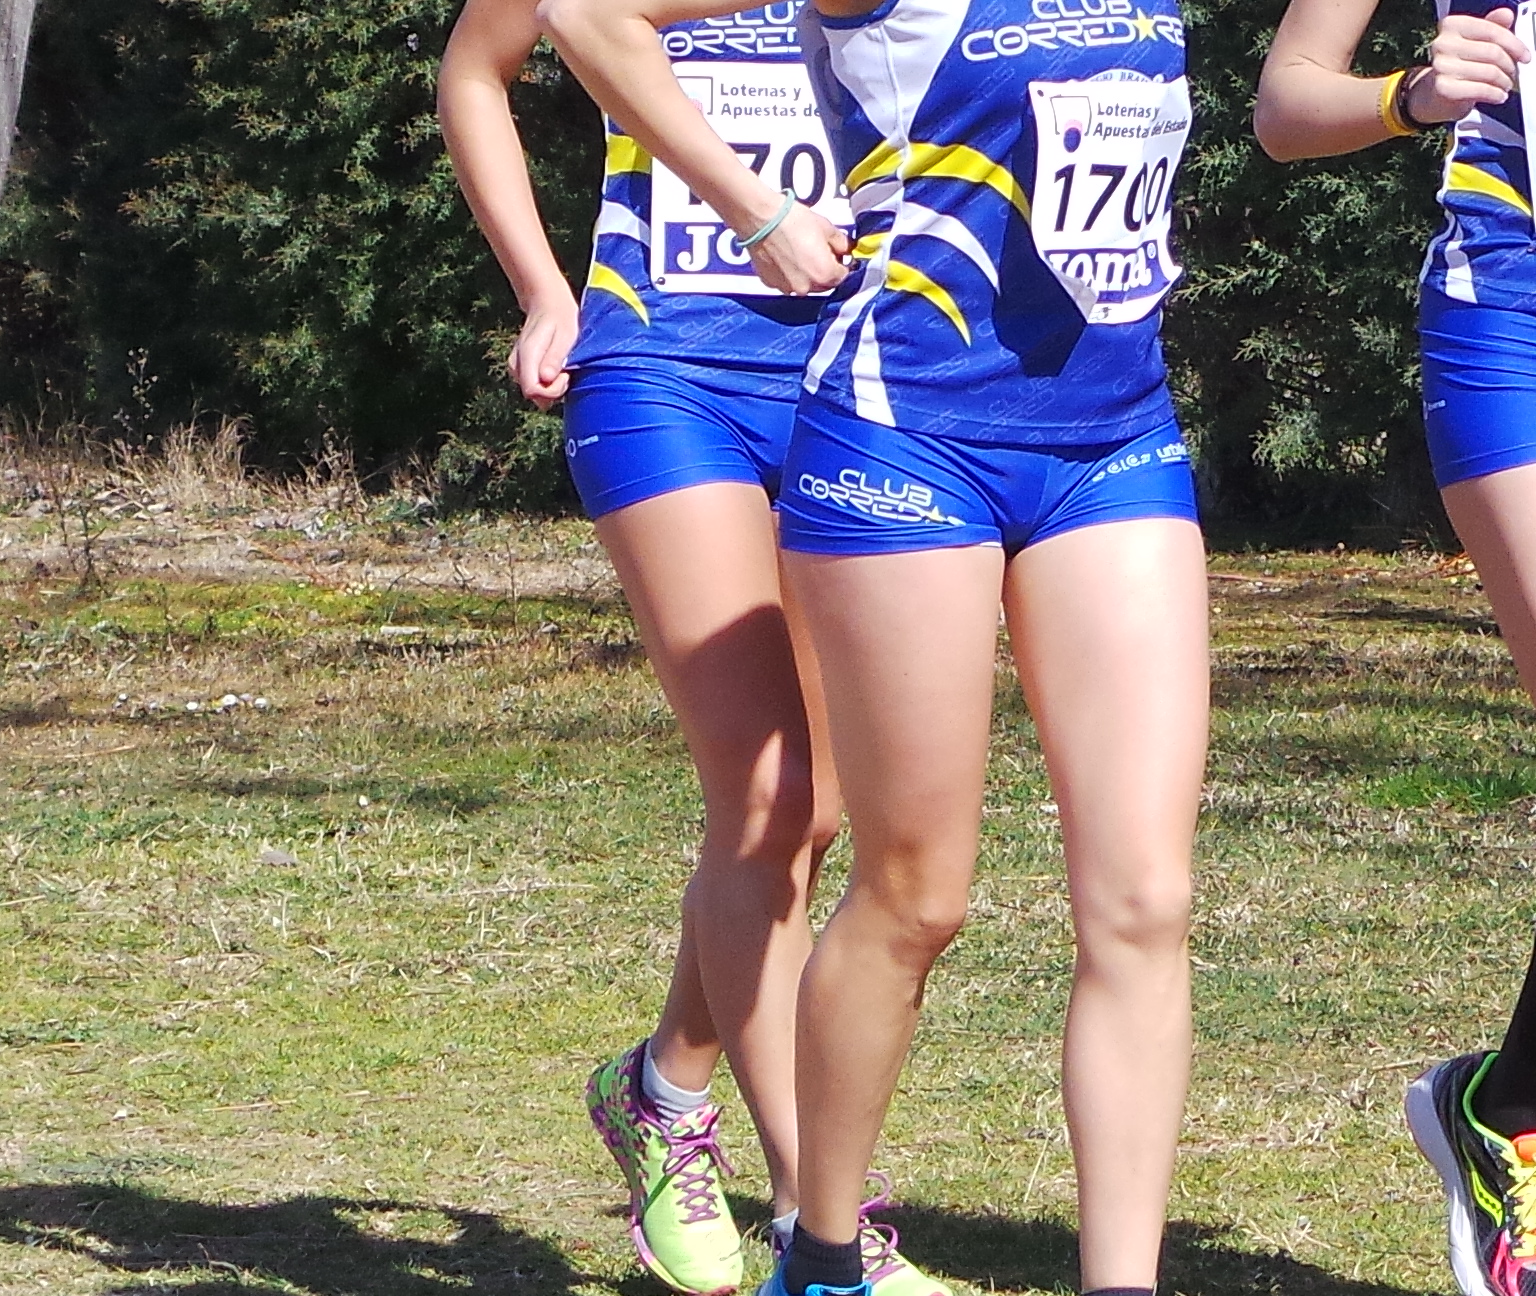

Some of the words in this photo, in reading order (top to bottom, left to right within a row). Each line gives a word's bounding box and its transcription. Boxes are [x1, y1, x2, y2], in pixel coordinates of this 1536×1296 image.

[658, 26, 802, 57] ORRE
[793, 86, 802, 101] y
[720, 103, 797, 119] Apuestas
[1151, 107, 1161, 122] y
[1093, 122, 1151, 141] Apuesta
[688, 142, 827, 208] 70
[1053, 156, 1168, 232] 1700
[677, 225, 751, 272] Jo
[839, 468, 932, 507] CLUB
